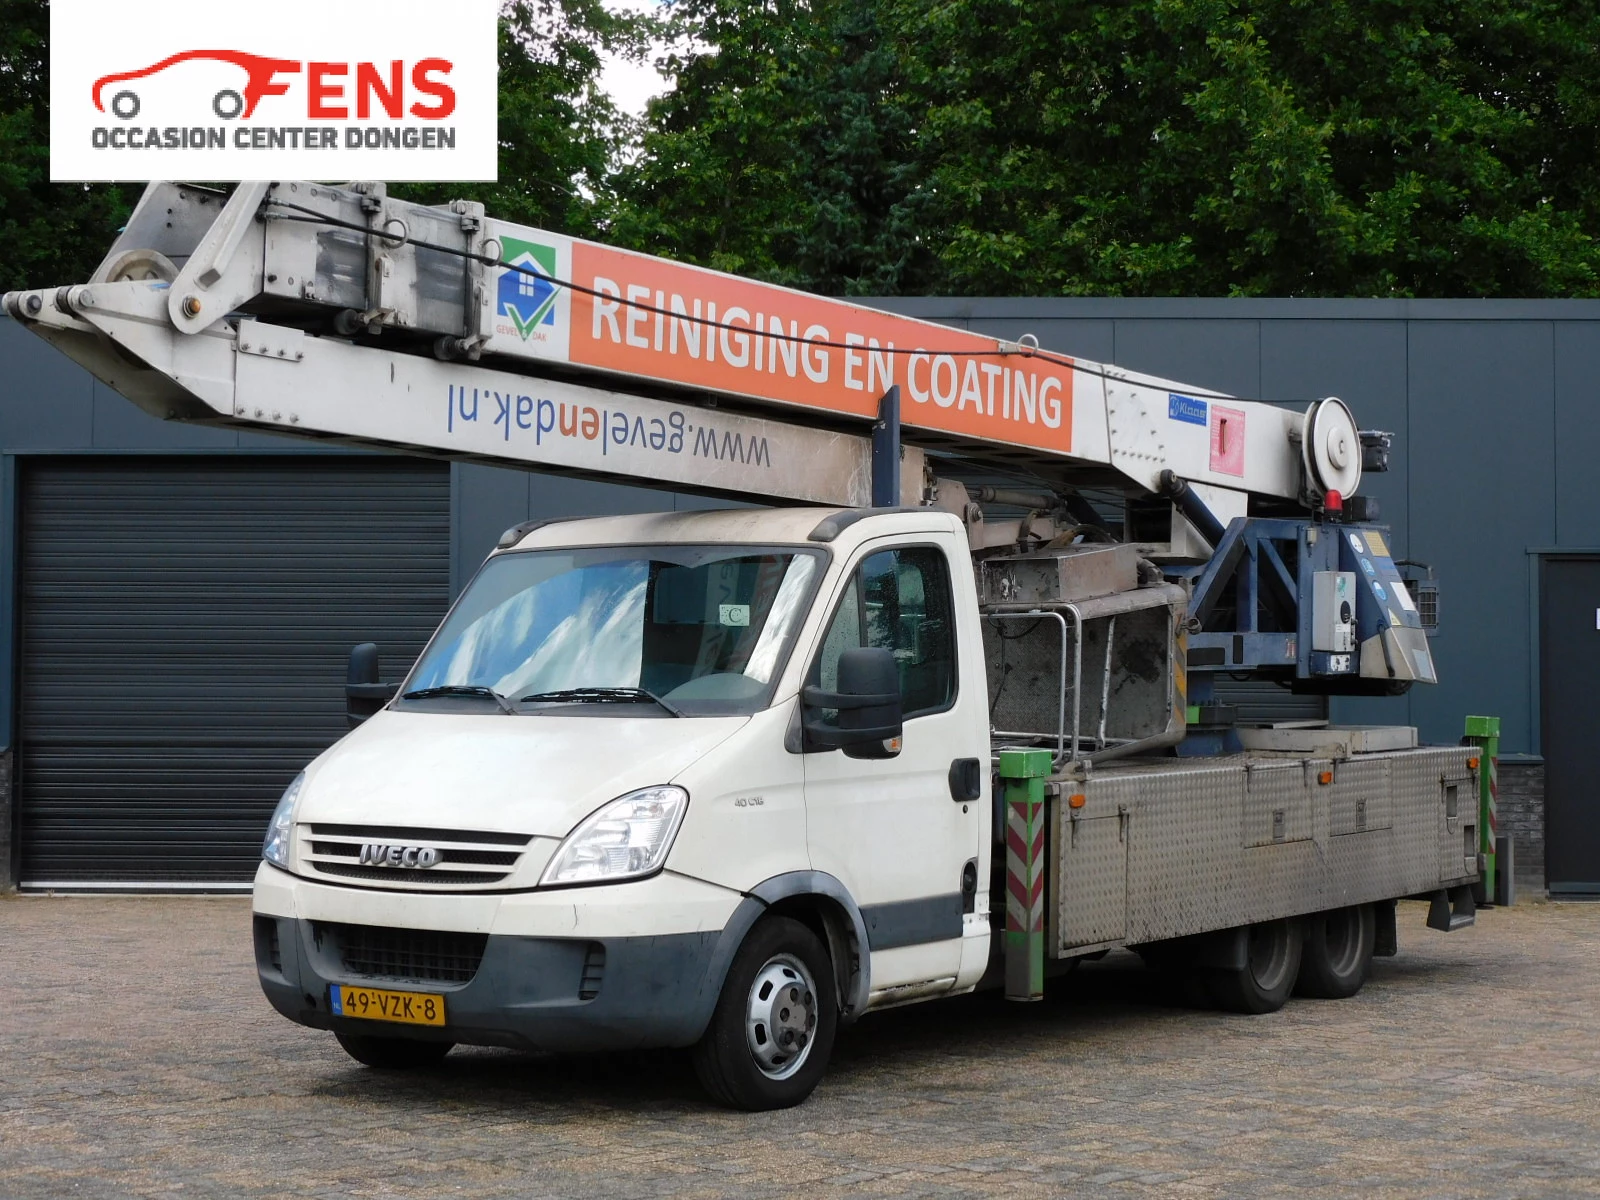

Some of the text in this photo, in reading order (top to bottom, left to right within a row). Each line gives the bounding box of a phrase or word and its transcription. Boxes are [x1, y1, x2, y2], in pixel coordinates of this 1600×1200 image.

[496, 325, 519, 337] GEVEL
[532, 331, 547, 342] DAK
[592, 276, 1062, 428] REINIGING EN COATING
[447, 385, 771, 467] www.gevelendak.nl
[359, 844, 437, 868] IVECO
